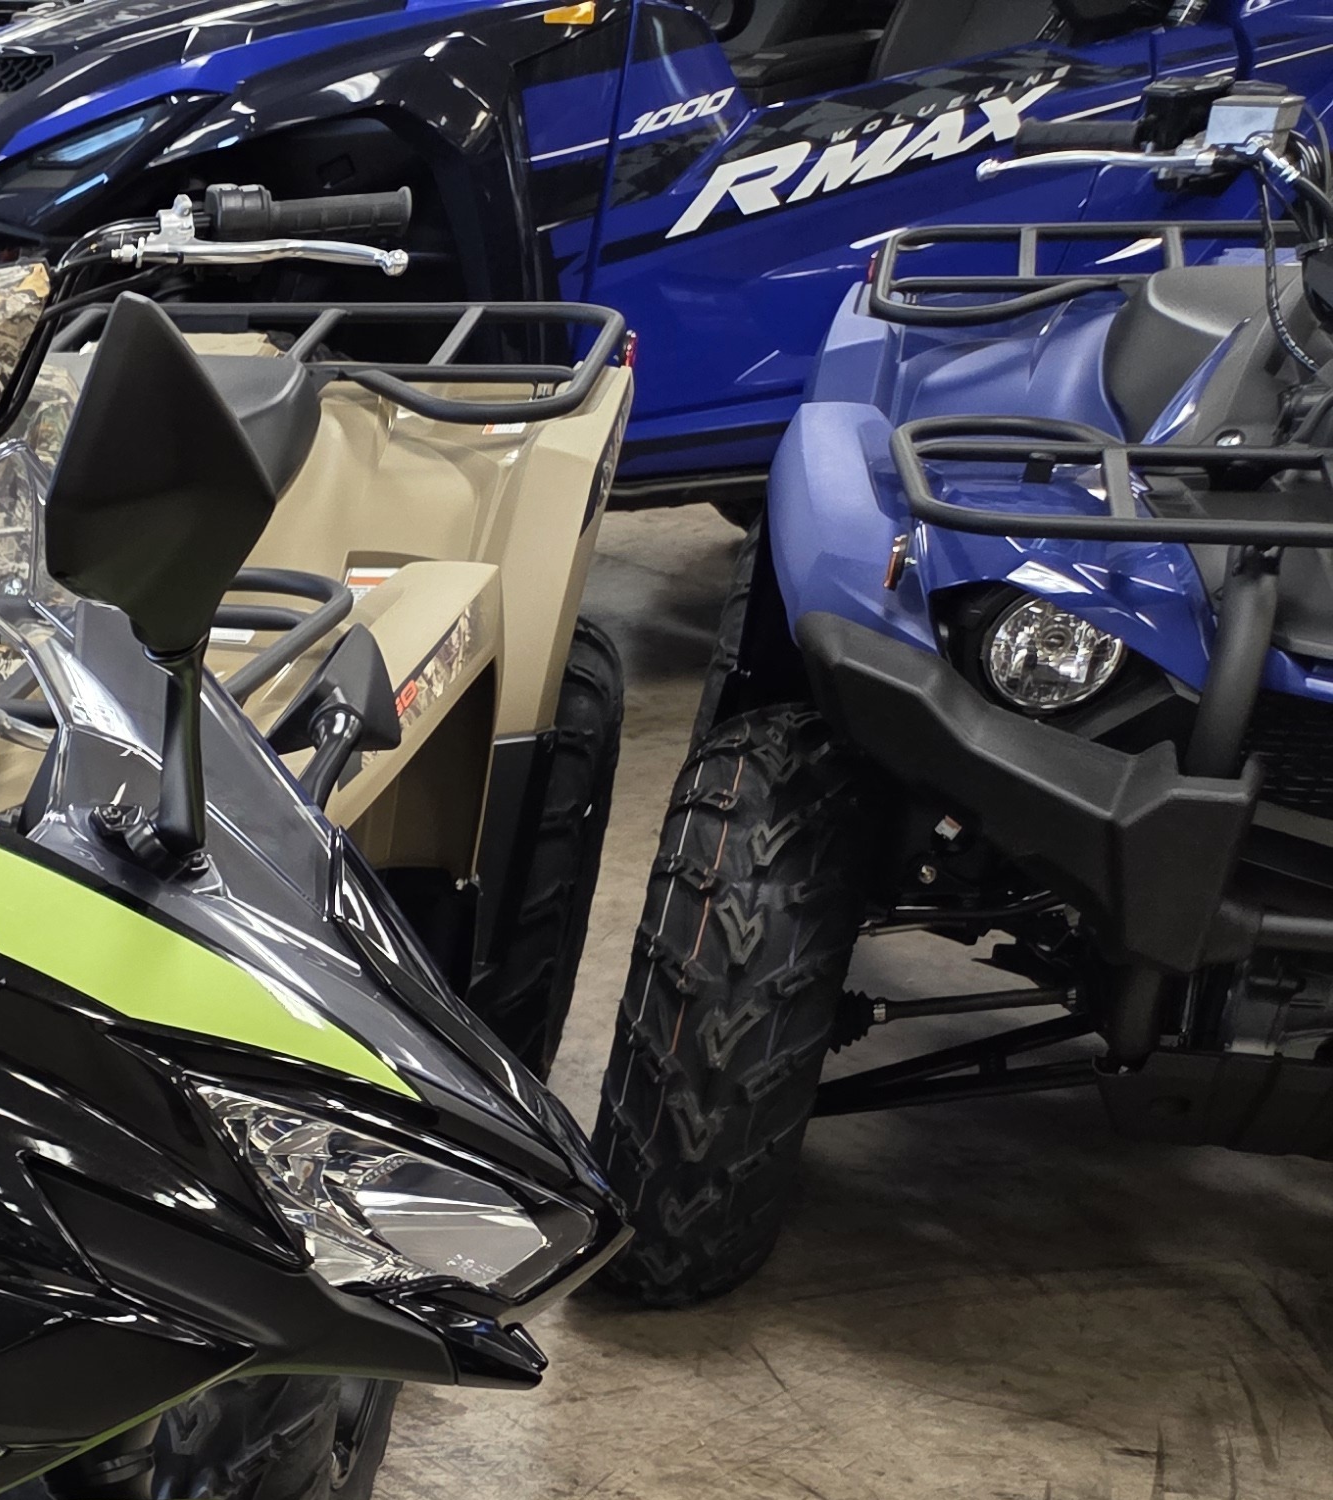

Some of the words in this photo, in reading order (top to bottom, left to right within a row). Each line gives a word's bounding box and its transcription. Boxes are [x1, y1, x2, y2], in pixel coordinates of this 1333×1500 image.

[618, 87, 735, 140] 1000
[831, 65, 1071, 142] WOLVERINE
[665, 80, 1060, 239] RMAX
